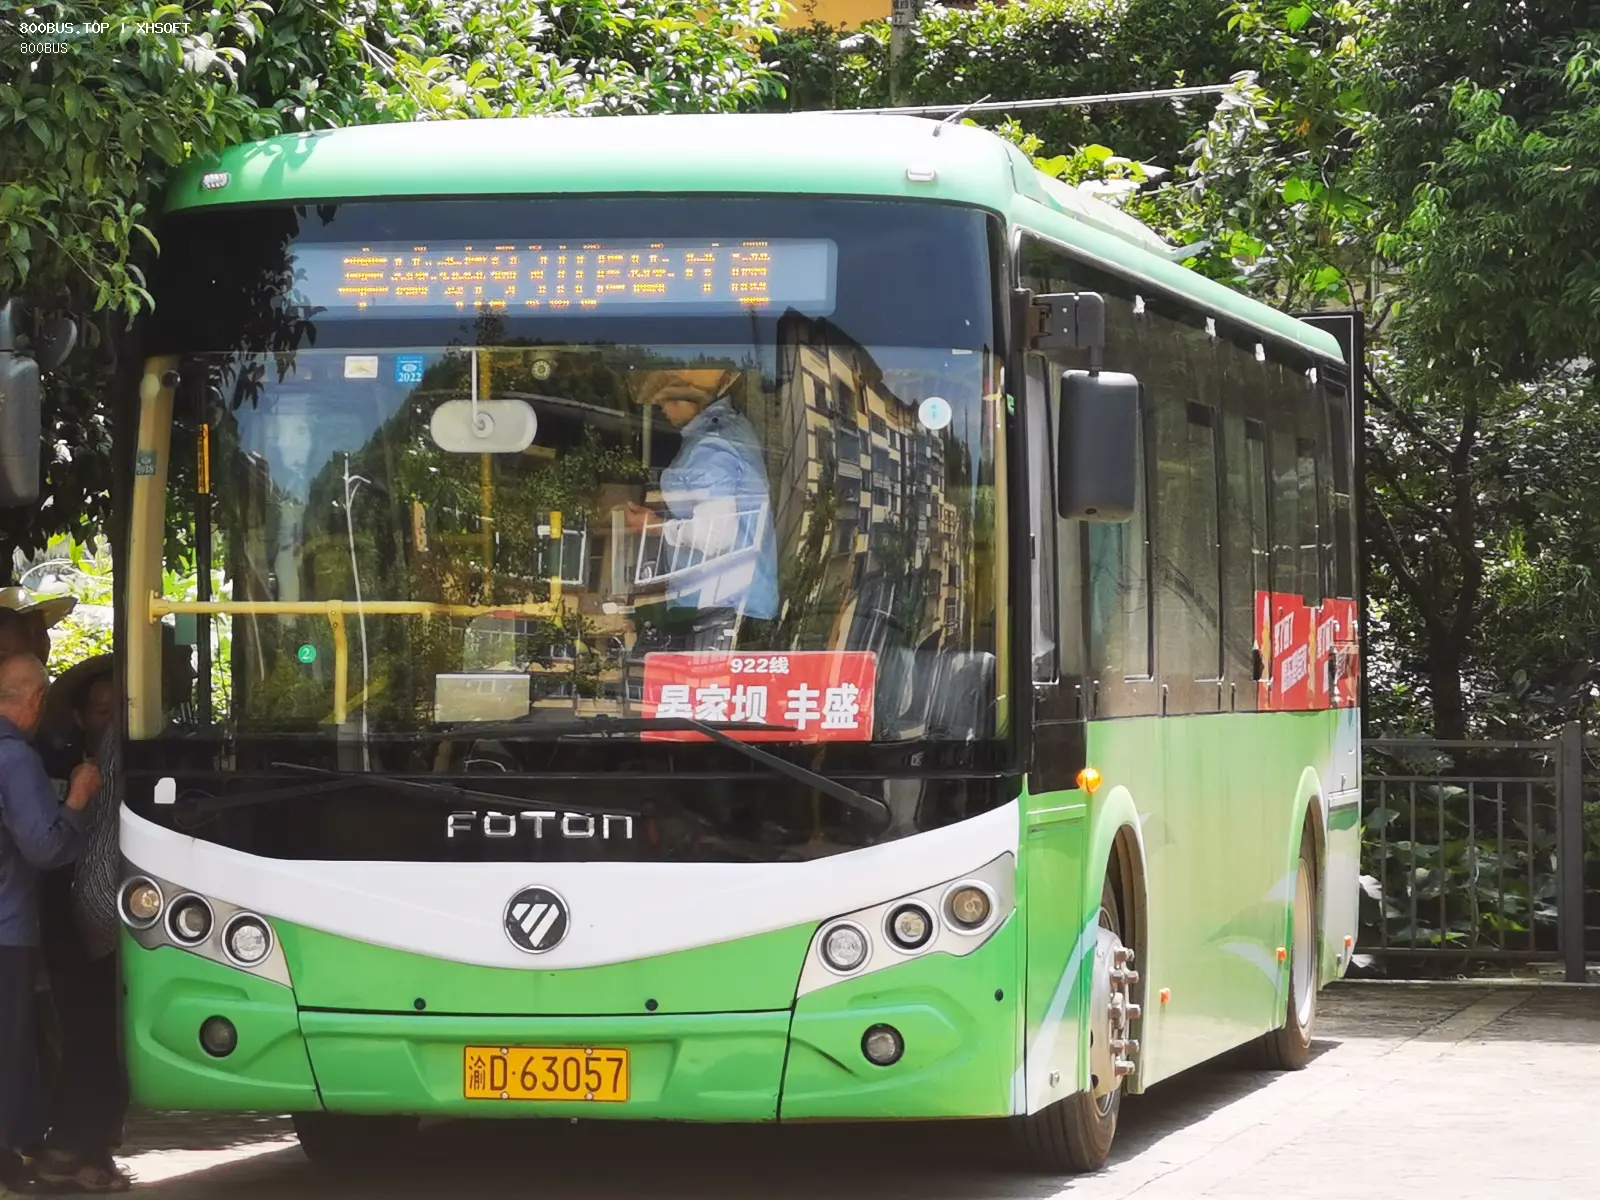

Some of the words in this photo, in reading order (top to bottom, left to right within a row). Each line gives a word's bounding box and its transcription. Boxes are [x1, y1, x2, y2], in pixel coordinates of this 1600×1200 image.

[398, 372, 422, 383] 2022
[730, 656, 790, 675] 922线
[784, 683, 860, 730] 丰盛
[447, 811, 633, 839] FOTON
